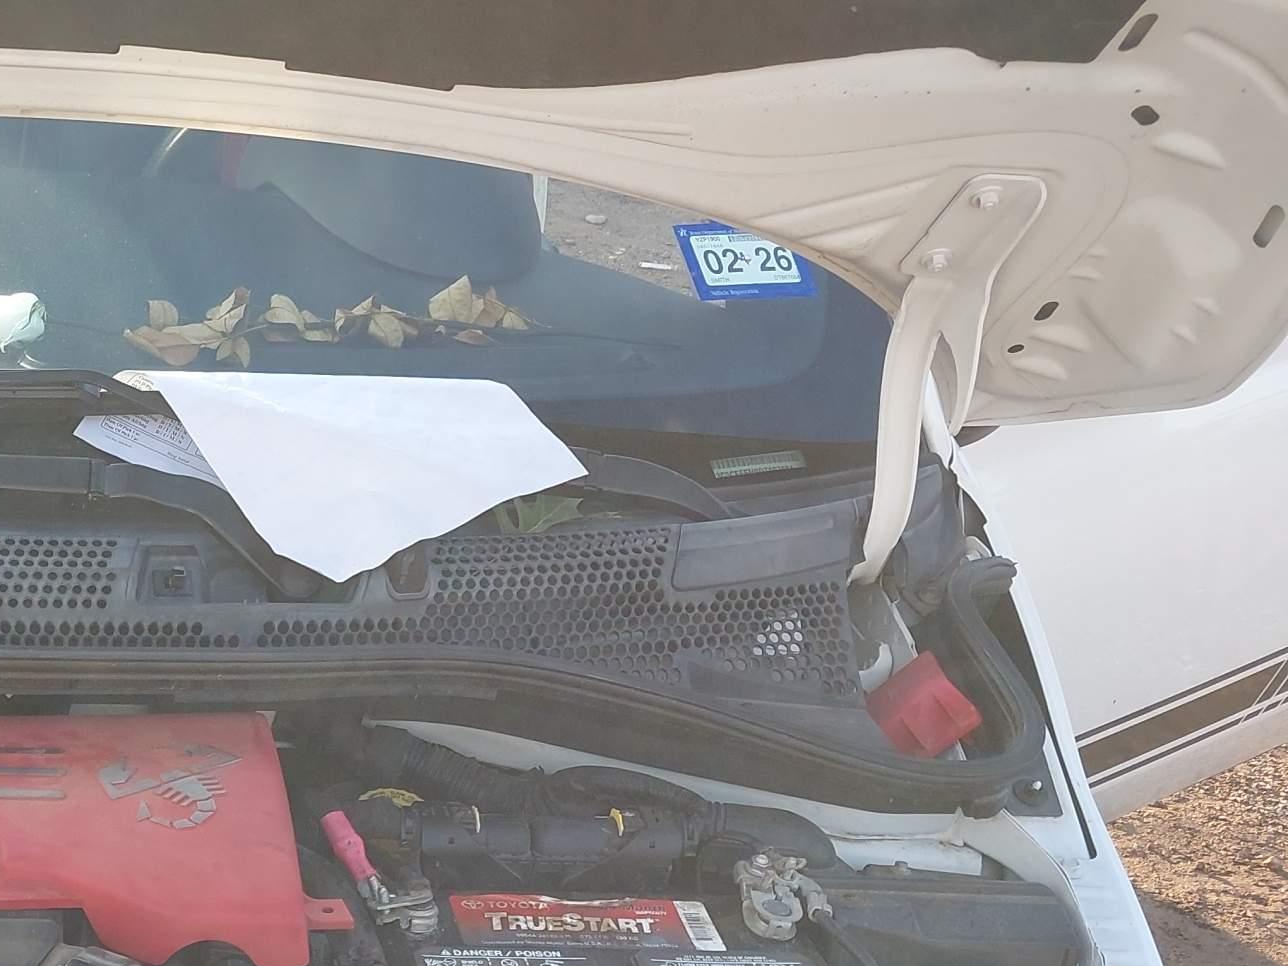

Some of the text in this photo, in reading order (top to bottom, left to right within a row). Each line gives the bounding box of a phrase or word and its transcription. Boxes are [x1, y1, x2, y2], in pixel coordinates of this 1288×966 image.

[703, 246, 793, 275] 02 26
[484, 900, 549, 910] TOYOTA
[453, 949, 503, 958] DANGER
[515, 950, 561, 958] POISON
